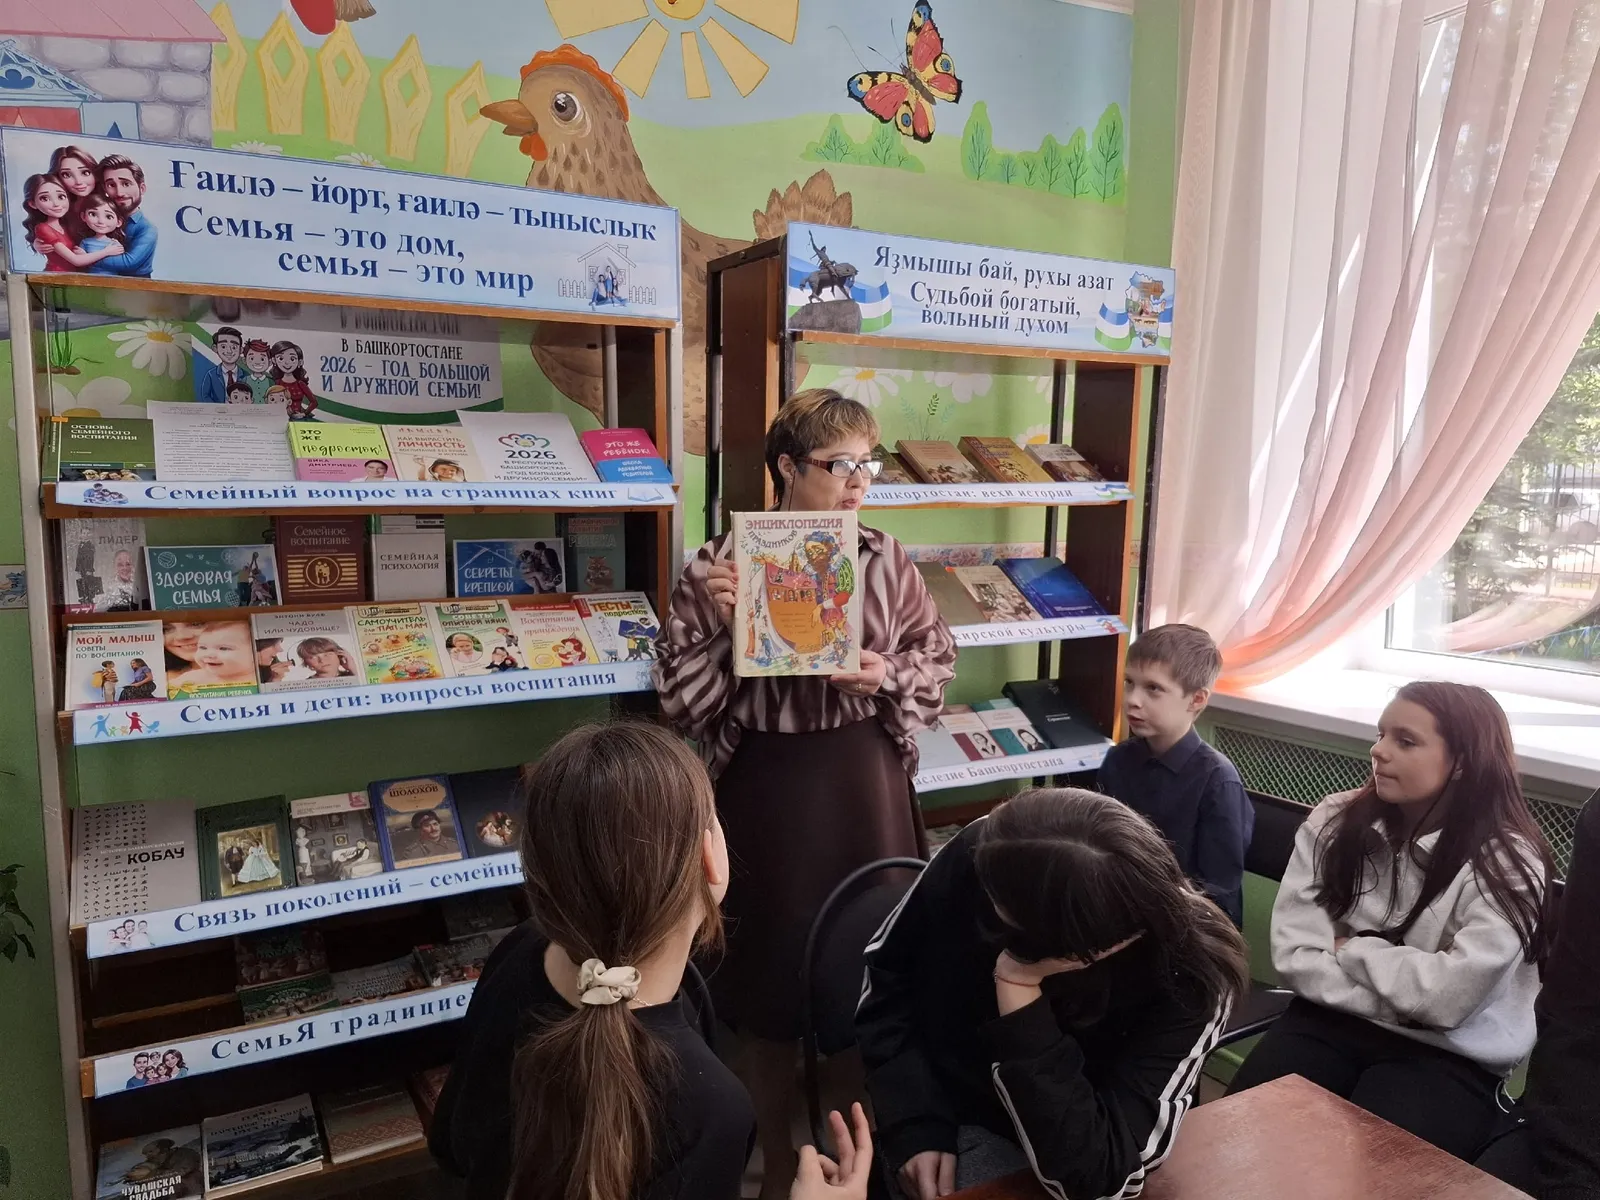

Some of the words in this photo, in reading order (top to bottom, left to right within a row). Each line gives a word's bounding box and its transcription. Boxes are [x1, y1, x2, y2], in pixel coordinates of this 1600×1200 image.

[168, 160, 276, 198] Ғаилә
[311, 175, 390, 215] йорт,
[397, 193, 480, 220] ғаилә
[509, 206, 657, 242] тыныслыҡ
[175, 205, 295, 242] Семья
[334, 227, 387, 250] это
[396, 234, 465, 263] дом,
[278, 252, 379, 278] семья
[416, 263, 465, 286] это
[475, 269, 534, 298] мир
[873, 246, 972, 277] Яҙмышы
[979, 257, 1018, 284] бай,
[1024, 267, 1070, 290] рухы
[1077, 273, 1114, 291] азат
[910, 280, 993, 309] Судьбой
[1000, 290, 1081, 319] богатый,
[921, 308, 1009, 330] вольный
[1014, 315, 1068, 337] духом
[341, 338, 349, 352] В
[356, 340, 463, 361] БАШКОРТОСТАНЕ
[320, 356, 357, 374] 2026
[382, 360, 410, 378] ГОД
[420, 362, 491, 382] БОЛЬШОЙ
[322, 375, 333, 392] И
[343, 376, 420, 396] ДРУЖНОЙ
[428, 381, 482, 399] СЕМЬИ!
[302, 444, 383, 457] подросток!
[397, 441, 466, 449] ЛИЧНОСТЬ
[604, 440, 624, 449] ЭТО
[504, 449, 556, 460] 2026
[144, 484, 298, 501] Семейный
[308, 487, 397, 502] вопрос
[405, 487, 433, 499] на
[441, 487, 561, 502] страницах
[568, 489, 618, 500] книг
[981, 489, 1012, 499] вехи
[1018, 488, 1073, 500] истории
[293, 525, 347, 536] Семейное
[745, 518, 843, 530] ЭНЦИКЛОПЕДИЯ
[98, 535, 139, 545] ЛИДЕР
[290, 536, 351, 546] воспитание
[748, 529, 798, 549] ПРАЗДНИКОВ
[380, 552, 439, 561] СЕМЕЙНАЯ
[155, 570, 233, 588] ЗДОРОВАЯ
[464, 566, 514, 579] СЕКРЕТЫ
[464, 580, 514, 594] КРЕПКОЙ
[172, 589, 221, 606] СЕМЬЯ
[589, 601, 632, 612] ТЕСТЫ
[520, 616, 576, 625] Воспитание
[604, 610, 648, 618] подростков
[357, 616, 426, 627] САМОУЧИТЕЛЬ
[442, 619, 482, 627] ОПЫТНОЙ
[286, 625, 340, 634] ЧУДОВИЩЕ?
[954, 627, 1013, 642] кирской
[1018, 623, 1086, 639] культуры
[76, 635, 103, 645] МОЙ
[108, 634, 155, 644] МАЛЫШ
[91, 650, 144, 659] ВОСПИТАНИЮ
[180, 705, 270, 723] Семья
[280, 701, 295, 715] и
[305, 694, 371, 715] дети:
[381, 683, 484, 705] вопросы
[491, 671, 617, 694] воспитания
[914, 770, 964, 786] аследие
[967, 757, 1065, 778] Башкортостана
[389, 785, 439, 797] ШОЛОХОВ
[127, 847, 185, 865] КОБАУ
[174, 908, 256, 933] Связь
[265, 878, 402, 917] поколений
[211, 1021, 317, 1060] СемьЯ
[330, 988, 475, 1036] традицие
[121, 1175, 182, 1196] ЧУВАШСКАЯ
[129, 1185, 175, 1200] СВАДЬБА
